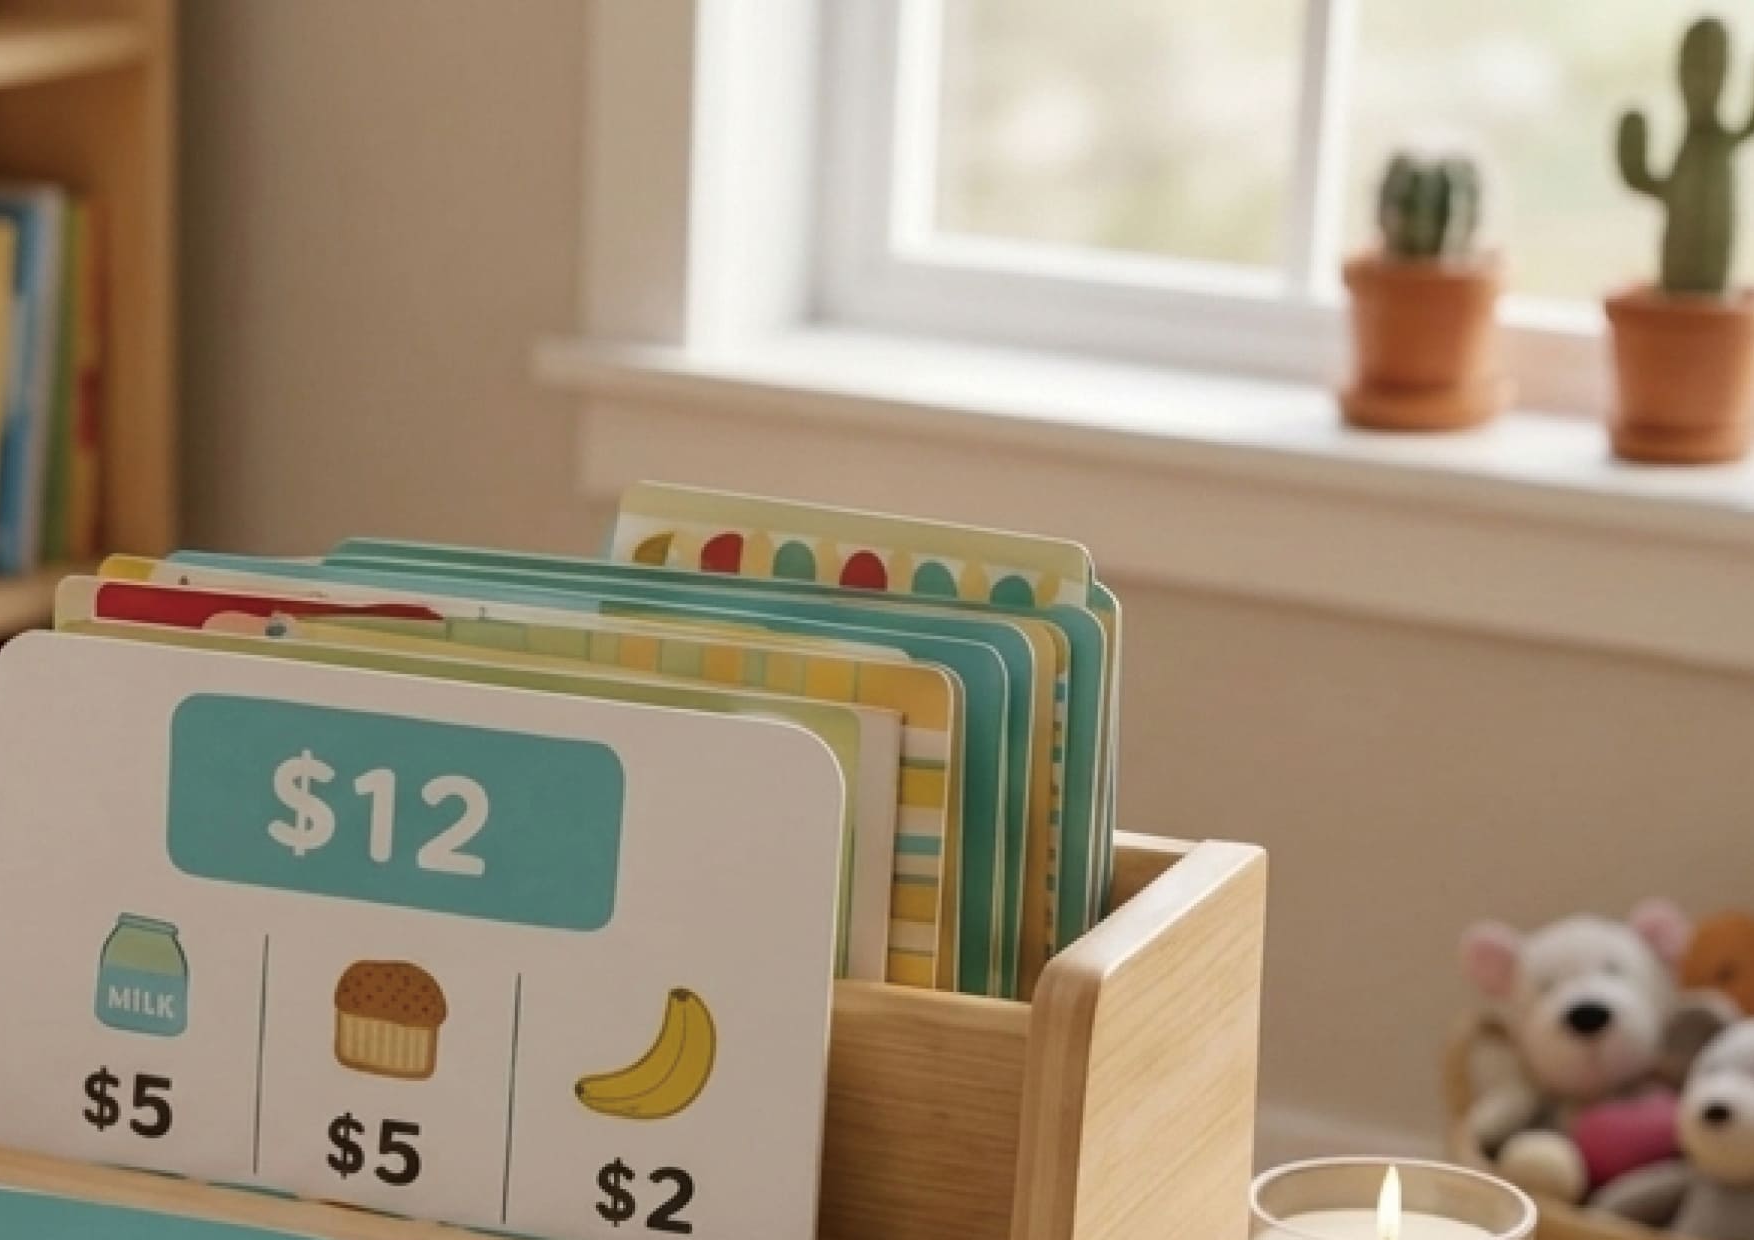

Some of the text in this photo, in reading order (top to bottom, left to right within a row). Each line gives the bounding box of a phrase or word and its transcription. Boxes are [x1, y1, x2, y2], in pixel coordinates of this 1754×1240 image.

[267, 748, 490, 877] $12
[107, 984, 177, 1021] MILK
[82, 1067, 174, 1139] $5
[326, 1112, 423, 1186] $5
[595, 1157, 695, 1234] $2
